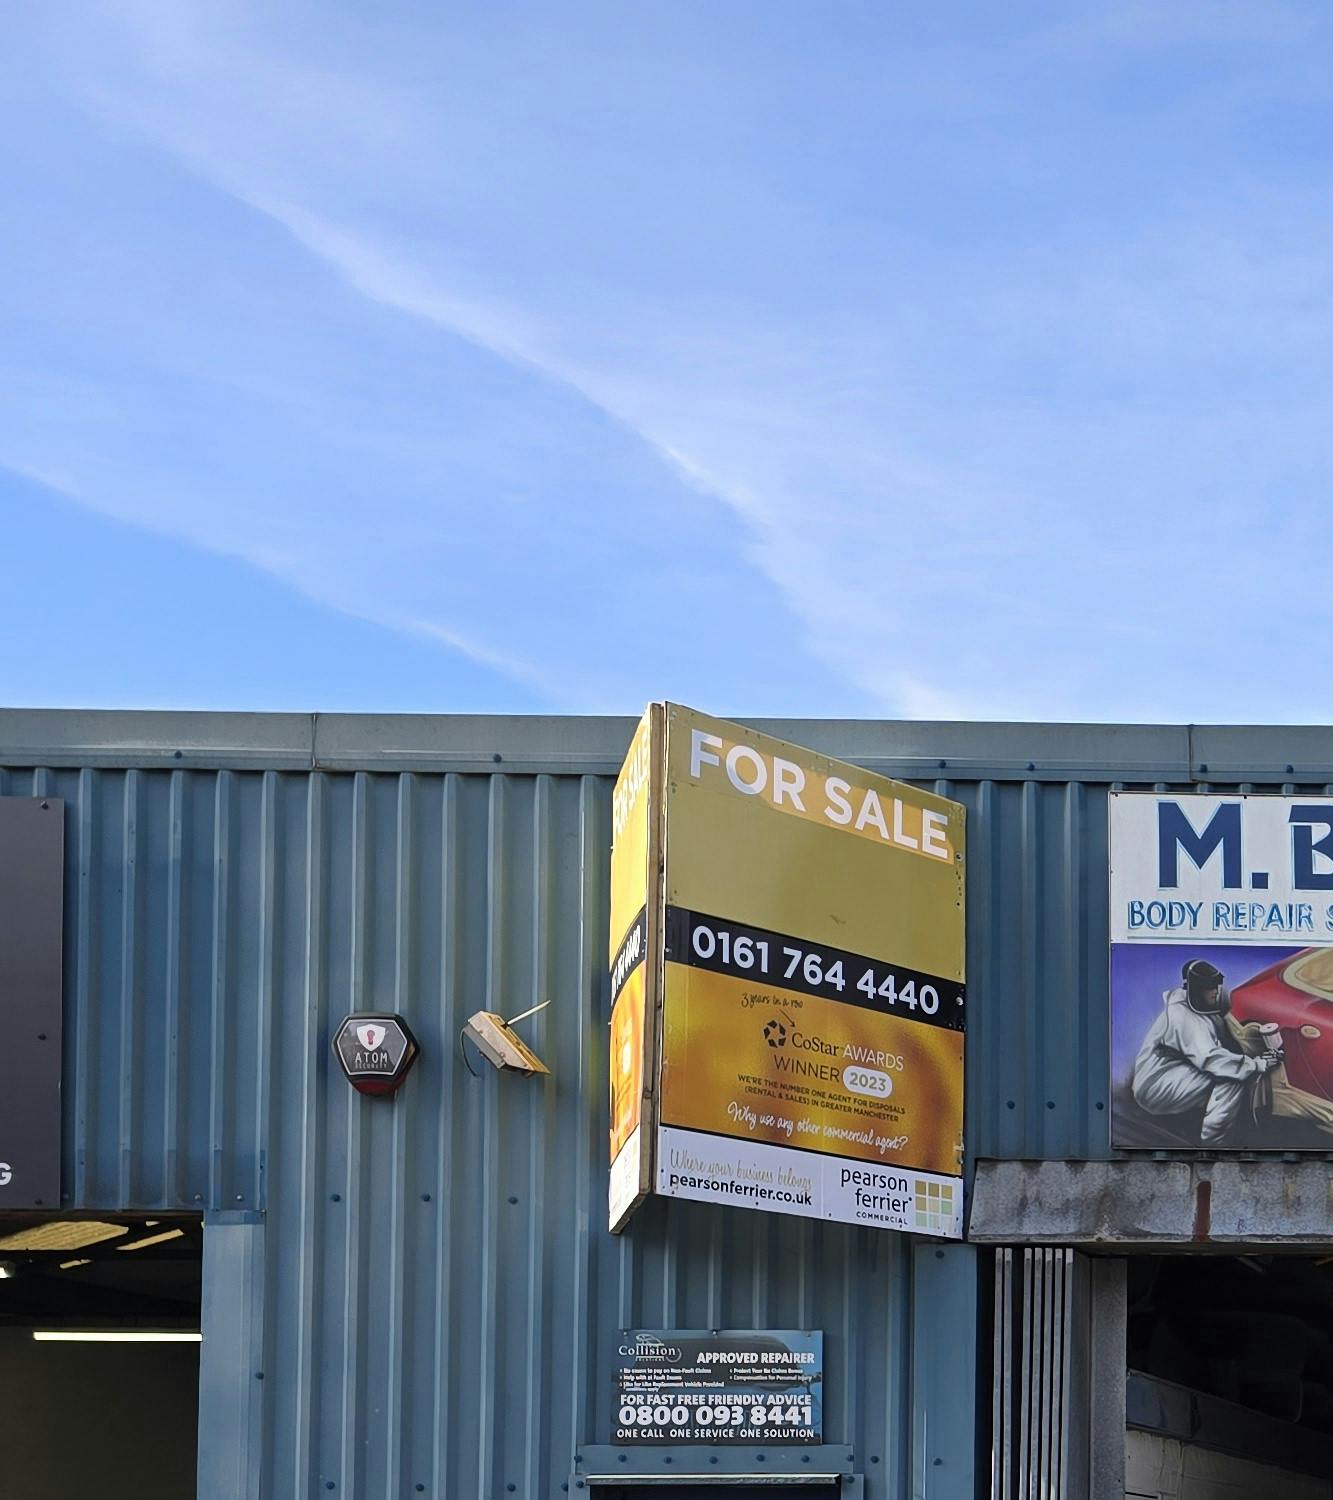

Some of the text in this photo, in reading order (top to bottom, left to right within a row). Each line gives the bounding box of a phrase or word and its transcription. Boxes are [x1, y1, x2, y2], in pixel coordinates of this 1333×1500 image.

[690, 728, 948, 859] FOR SALE
[1156, 801, 1269, 890] M.
[1127, 901, 1203, 931] BODY
[1213, 902, 1313, 932] REPAIR
[692, 925, 940, 1015] 0161 764 4440
[740, 992, 749, 1008] 3
[749, 993, 770, 1009] years
[355, 1052, 388, 1064] ATOM
[791, 1032, 905, 1071] CoStar AWARDS
[773, 1054, 887, 1092] WINNER 2023
[738, 1073, 906, 1115] WE'RE THE NUMBER ONE AGENT FOR DISPOSALS
[744, 1086, 777, 1099] (RENTAL
[785, 1093, 810, 1106] SALES)
[820, 1101, 852, 1113] GREATER
[853, 1108, 899, 1122] MANCHESTER
[727, 1101, 909, 1155] Why use any other commercial agent?
[670, 1149, 707, 1173] Where
[707, 1160, 734, 1184] your
[736, 1159, 774, 1185] business
[841, 1167, 908, 1193] pearson
[669, 1172, 813, 1206] pearsonferrier.co.uk
[855, 1189, 910, 1214] ferrier
[856, 1211, 909, 1226] COMMERCIAL
[696, 1352, 815, 1364] APPROVED REPAIRER
[618, 1405, 812, 1426] 0800 093 8441
[620, 1394, 812, 1406] FOR FAST FREE FRIENDLY ADVICE
[616, 1428, 815, 1438] ONE CALL ONE SERVICE ONE SOLUTION
